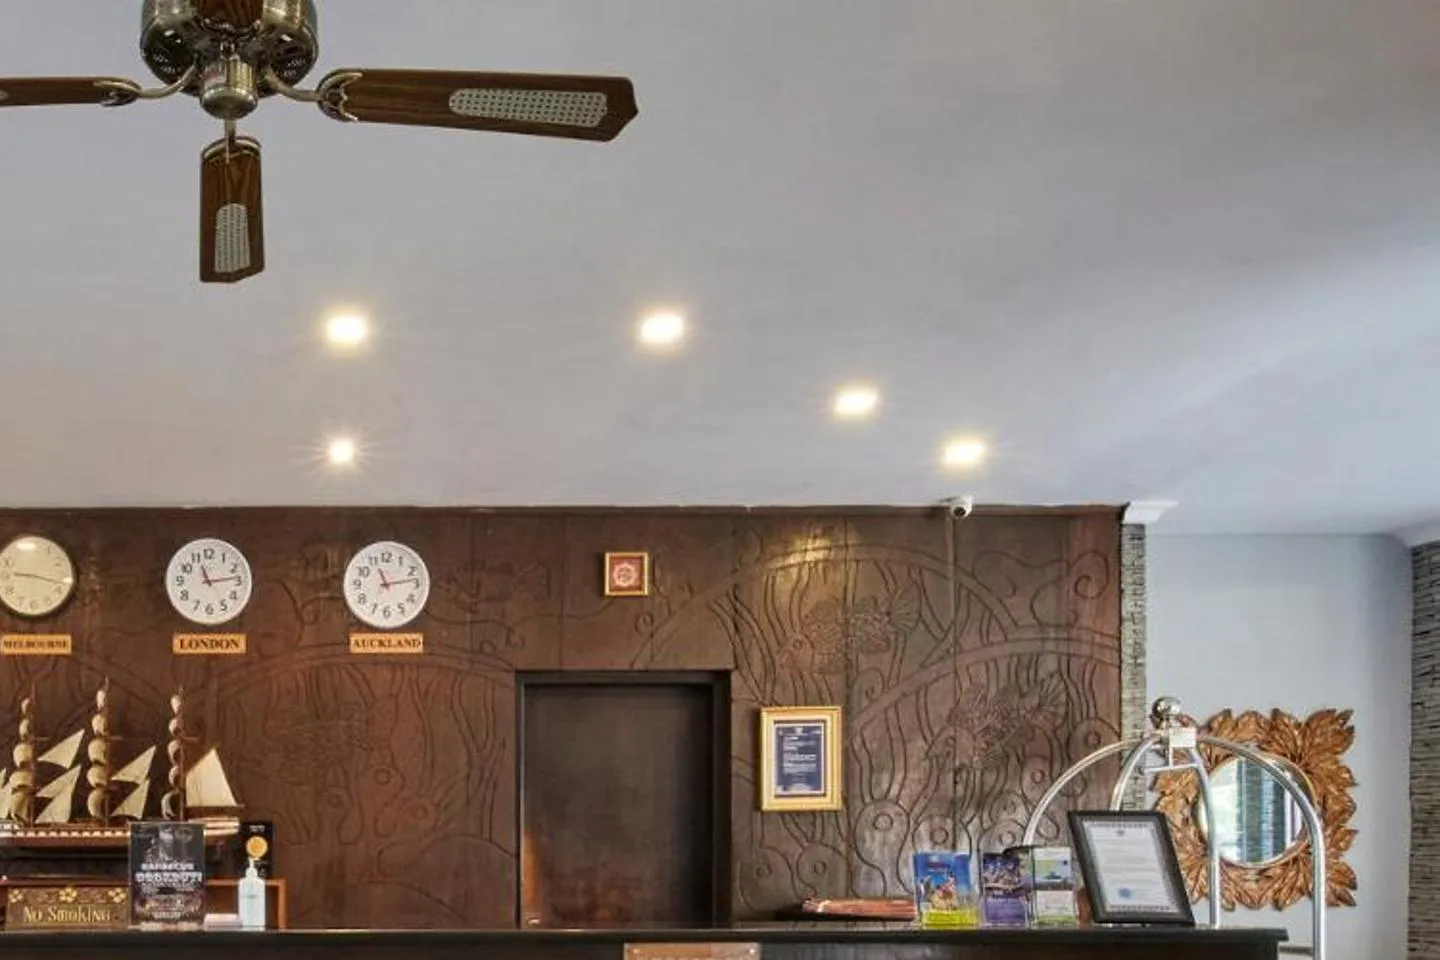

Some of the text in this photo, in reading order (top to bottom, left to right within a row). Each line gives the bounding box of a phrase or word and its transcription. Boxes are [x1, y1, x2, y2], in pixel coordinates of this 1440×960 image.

[191, 553, 200, 563] 11
[204, 549, 215, 559] 12
[381, 552, 392, 563] 12
[369, 556, 378, 566] 11
[230, 564, 237, 573] 2
[408, 567, 417, 576] 2
[176, 576, 184, 586] 9
[353, 579, 361, 589] 9
[180, 590, 189, 601] 8
[229, 591, 237, 600] 4
[358, 593, 367, 605] 8
[406, 594, 415, 603] 4
[193, 600, 200, 611] 7
[205, 604, 214, 615] 6
[220, 600, 227, 611] 5
[372, 603, 378, 614] 7
[397, 603, 405, 615] 5
[383, 606, 391, 618] 6
[180, 640, 240, 649] LONDON
[354, 640, 422, 648] AUCKLAND
